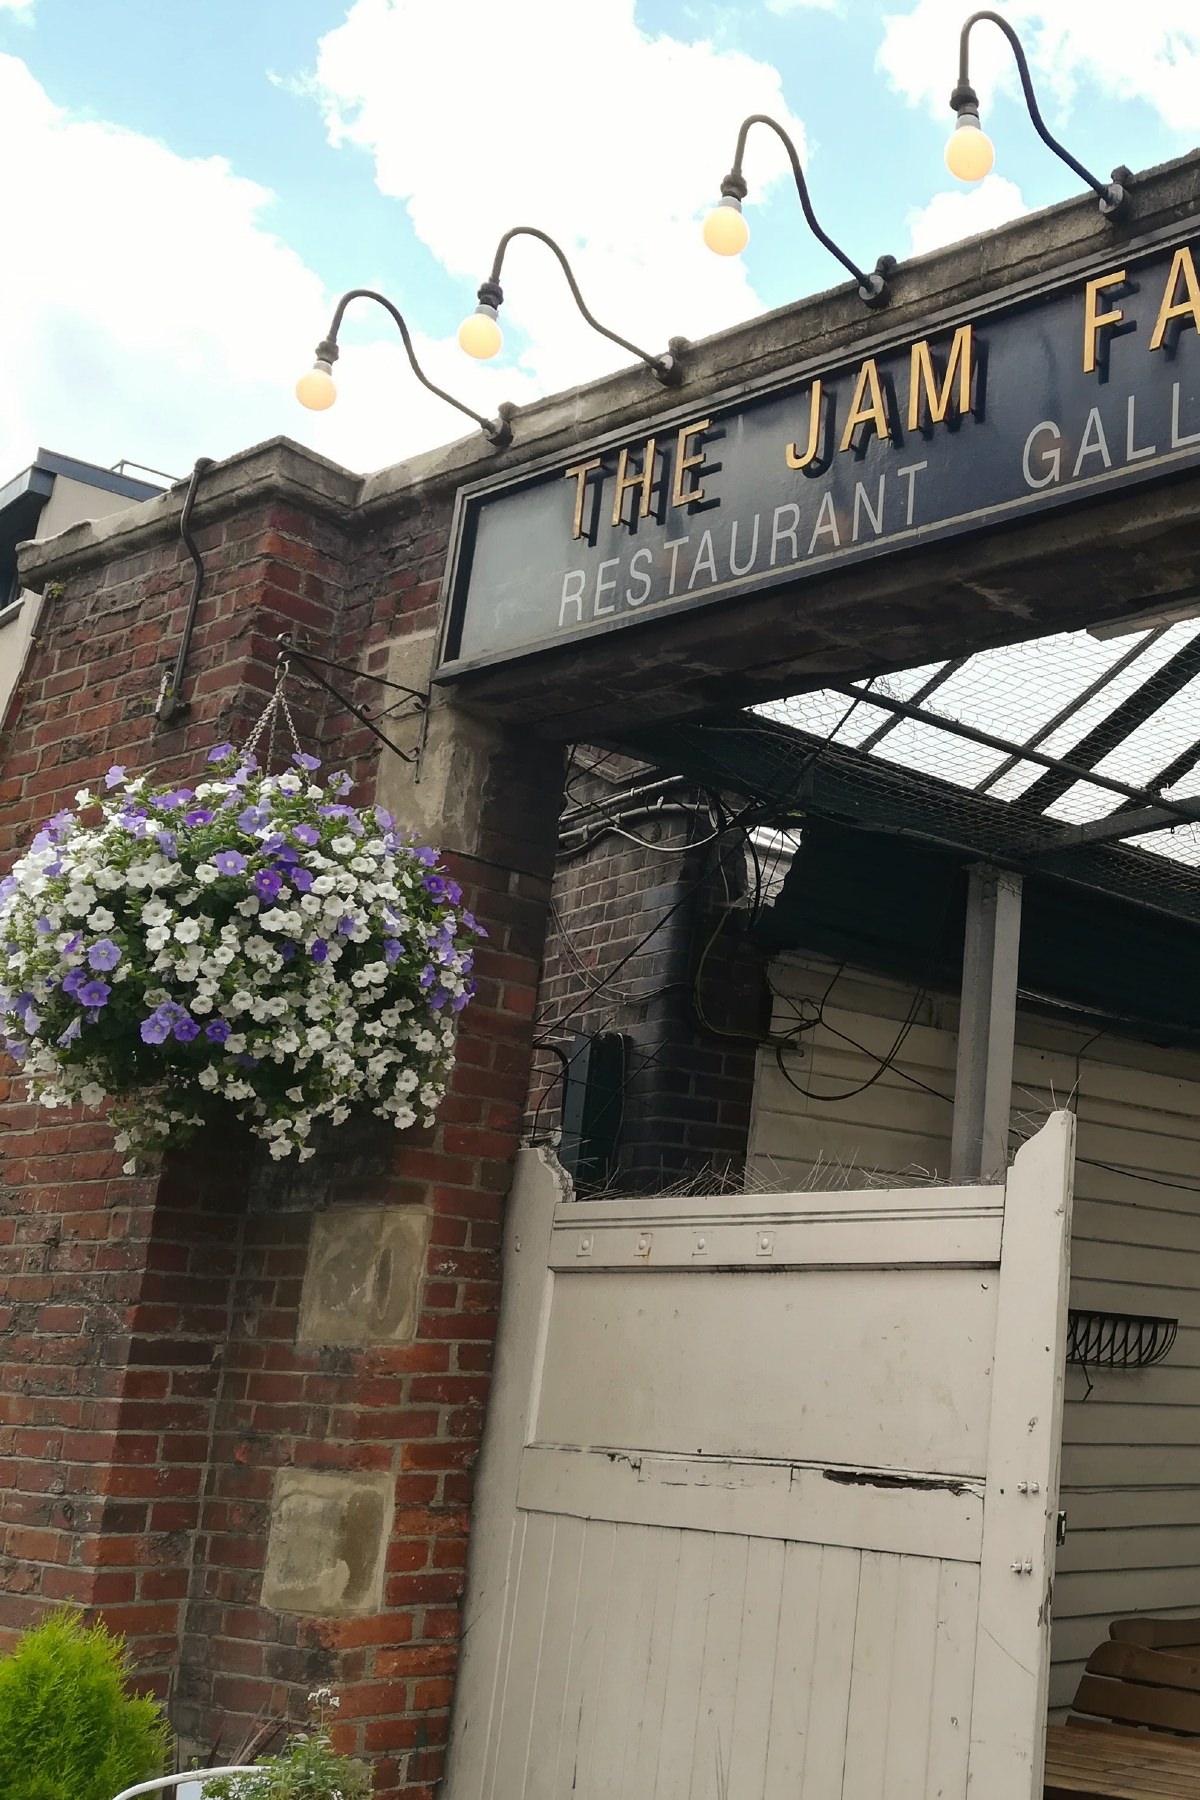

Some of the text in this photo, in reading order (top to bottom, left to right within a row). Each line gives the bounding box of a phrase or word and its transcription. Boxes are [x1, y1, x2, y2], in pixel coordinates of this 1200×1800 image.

[565, 419, 712, 541] THE
[785, 324, 974, 471] JAM
[557, 460, 929, 627] RESTAURANT
